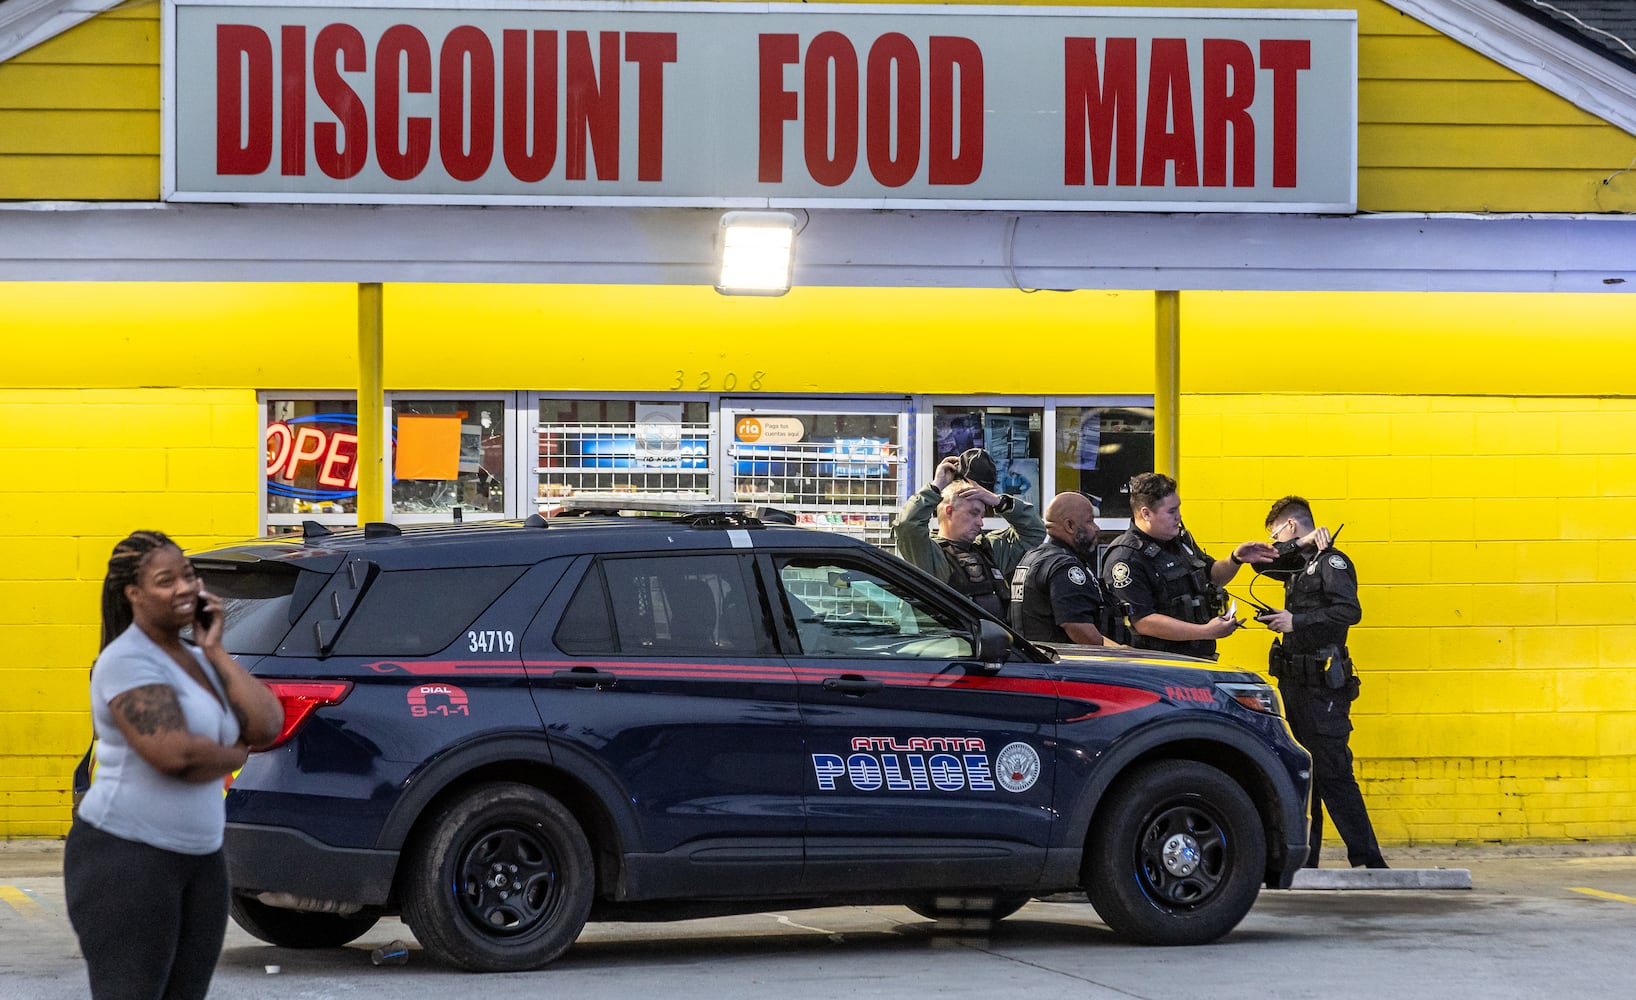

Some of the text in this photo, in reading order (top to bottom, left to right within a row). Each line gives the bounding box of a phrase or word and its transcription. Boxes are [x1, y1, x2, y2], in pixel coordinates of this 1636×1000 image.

[216, 23, 1312, 189] DISCOUNT FOOD MART
[669, 369, 766, 391] 3208
[739, 420, 759, 434] ria
[468, 630, 514, 653] 34719
[420, 686, 452, 694] DIAL
[1165, 684, 1217, 703] PATROL
[410, 704, 470, 718] 9-1-1
[851, 736, 986, 752] ATLANTA
[812, 753, 996, 792] POLICE
